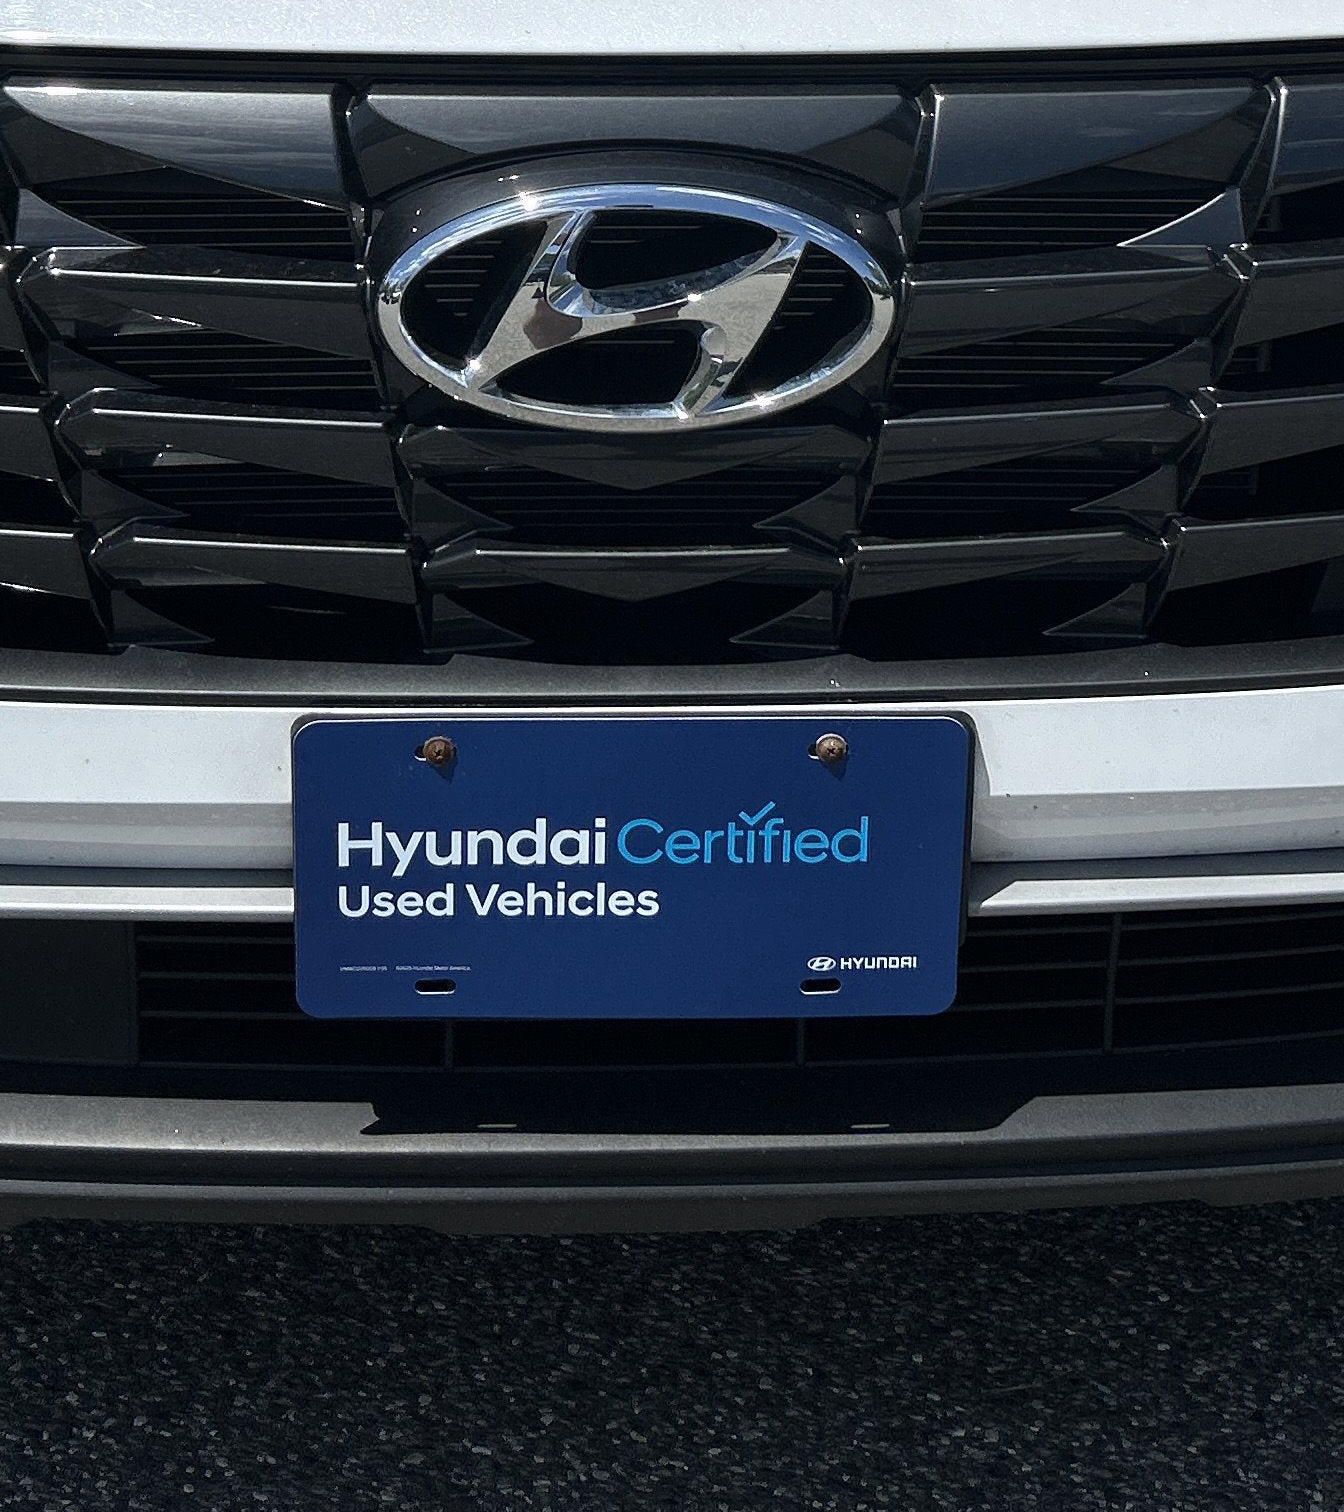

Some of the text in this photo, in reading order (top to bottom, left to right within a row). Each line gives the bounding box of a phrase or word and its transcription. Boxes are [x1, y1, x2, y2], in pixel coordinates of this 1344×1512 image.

[337, 801, 870, 877] Hyundai Certified
[338, 880, 660, 919] Used Vehicles
[840, 956, 917, 970] HYUNDAI
